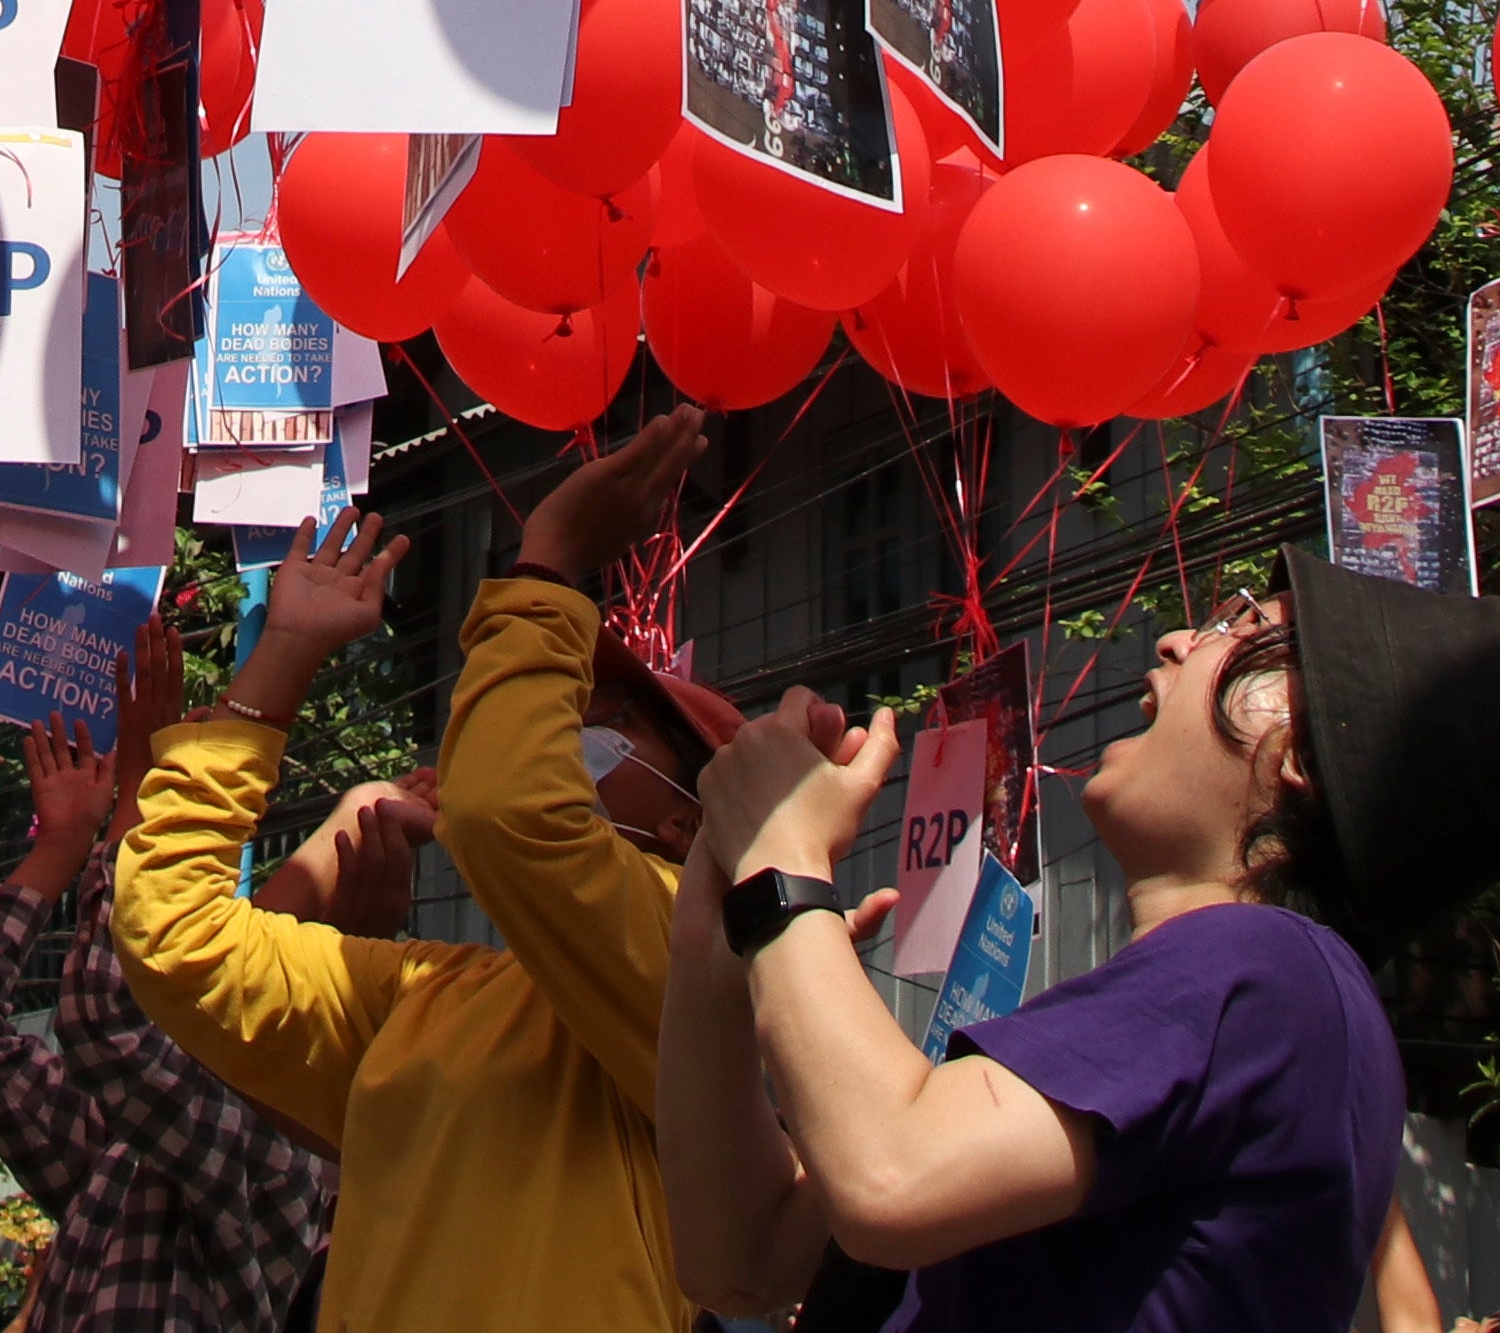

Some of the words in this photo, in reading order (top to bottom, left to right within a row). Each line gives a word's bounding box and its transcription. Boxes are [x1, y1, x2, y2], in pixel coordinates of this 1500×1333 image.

[254, 286, 300, 296] Nations
[257, 275, 299, 284] United
[222, 338, 264, 350] DEAD
[270, 338, 328, 350] BODIES
[232, 323, 270, 335] HOW
[275, 324, 319, 335] MANY
[217, 354, 237, 362] ARE
[241, 354, 284, 363] NEEDED
[288, 354, 301, 363] TO
[305, 354, 331, 363] TAKE
[225, 365, 322, 383] ACTION?
[58, 571, 113, 601] Nations
[20, 608, 67, 635] HOW
[71, 627, 124, 658] MANY
[3, 623, 56, 651] DEAD
[62, 644, 116, 678] BODIE
[23, 648, 75, 676] NEEDED
[79, 670, 95, 684] TO
[98, 678, 117, 695] TA
[906, 809, 969, 871] R2P
[986, 914, 1014, 947] United
[978, 932, 1011, 967] Nations
